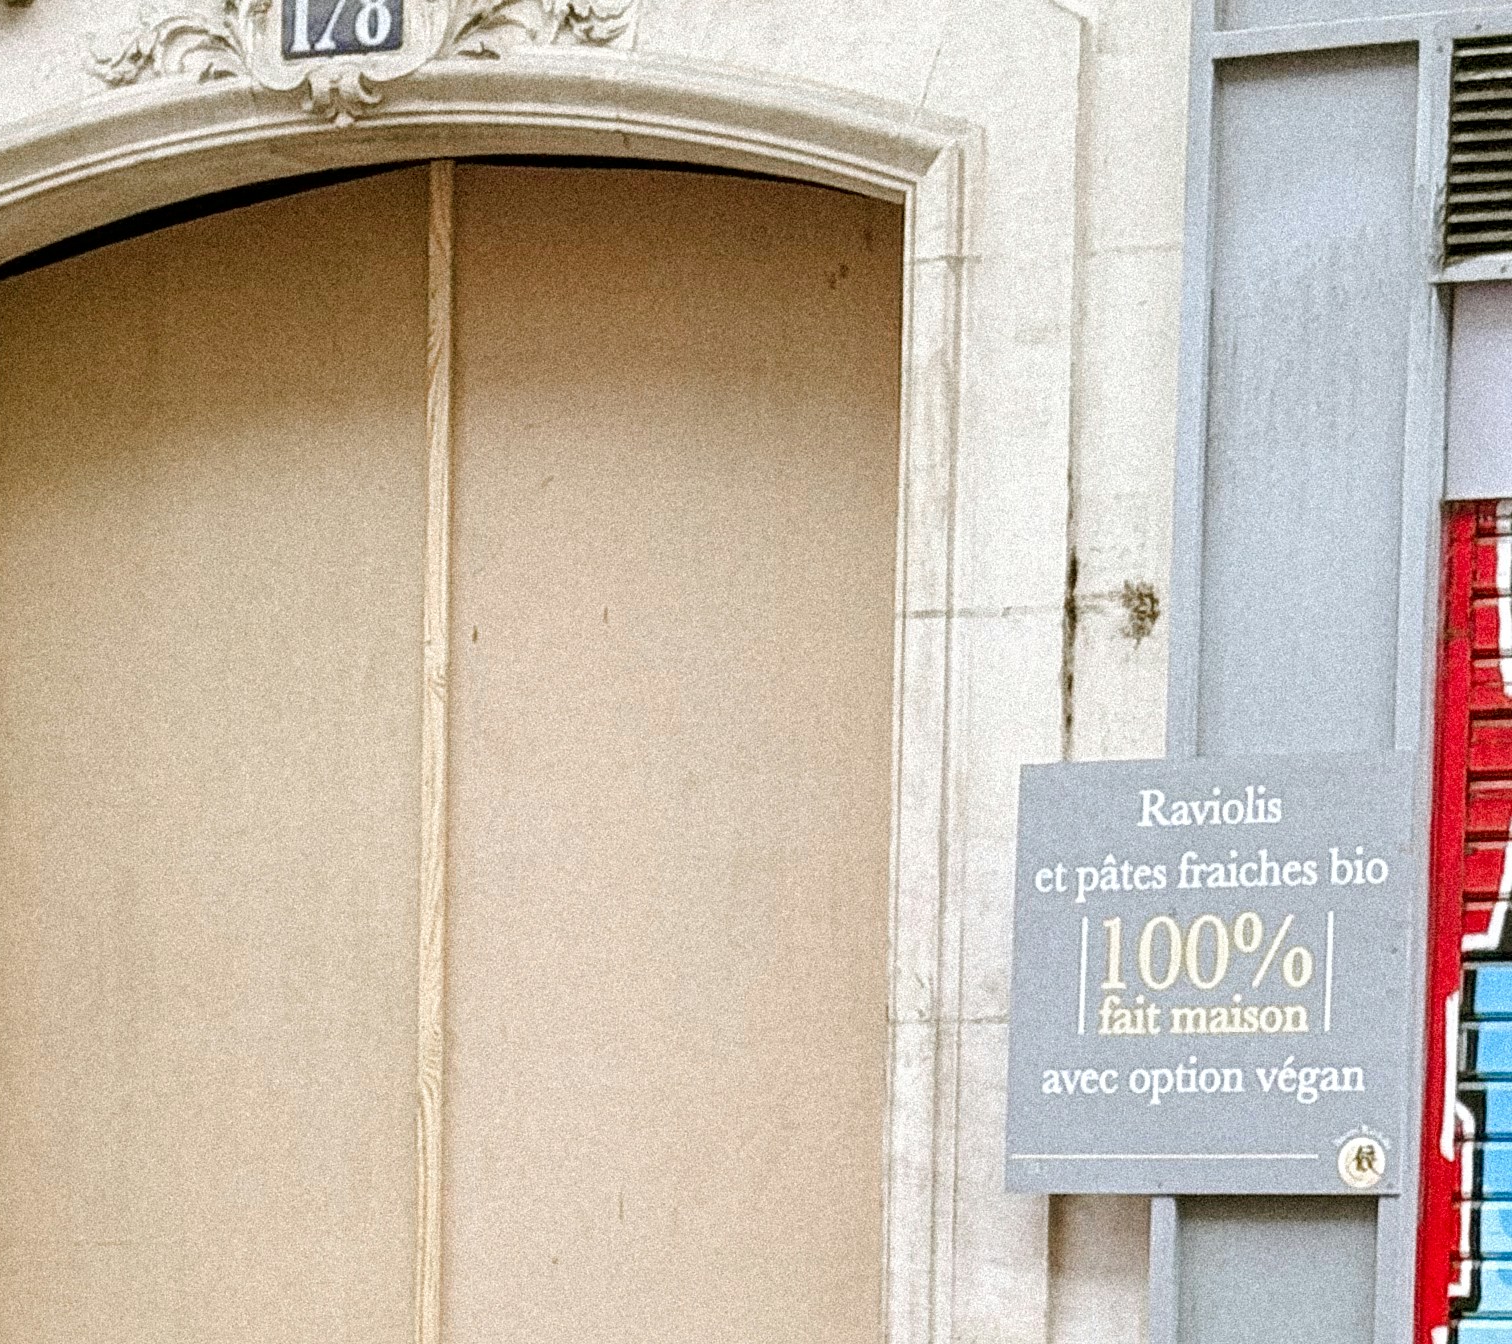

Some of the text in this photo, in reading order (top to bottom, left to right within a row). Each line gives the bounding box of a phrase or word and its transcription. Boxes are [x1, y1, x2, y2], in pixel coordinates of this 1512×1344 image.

[1137, 786, 1283, 828] Raviolis
[1034, 847, 1390, 903] et pâtes fraiches bio
[1100, 911, 1315, 991] 100%
[1097, 994, 1309, 1036] fait maison
[1041, 1056, 1365, 1105] avec option végan
